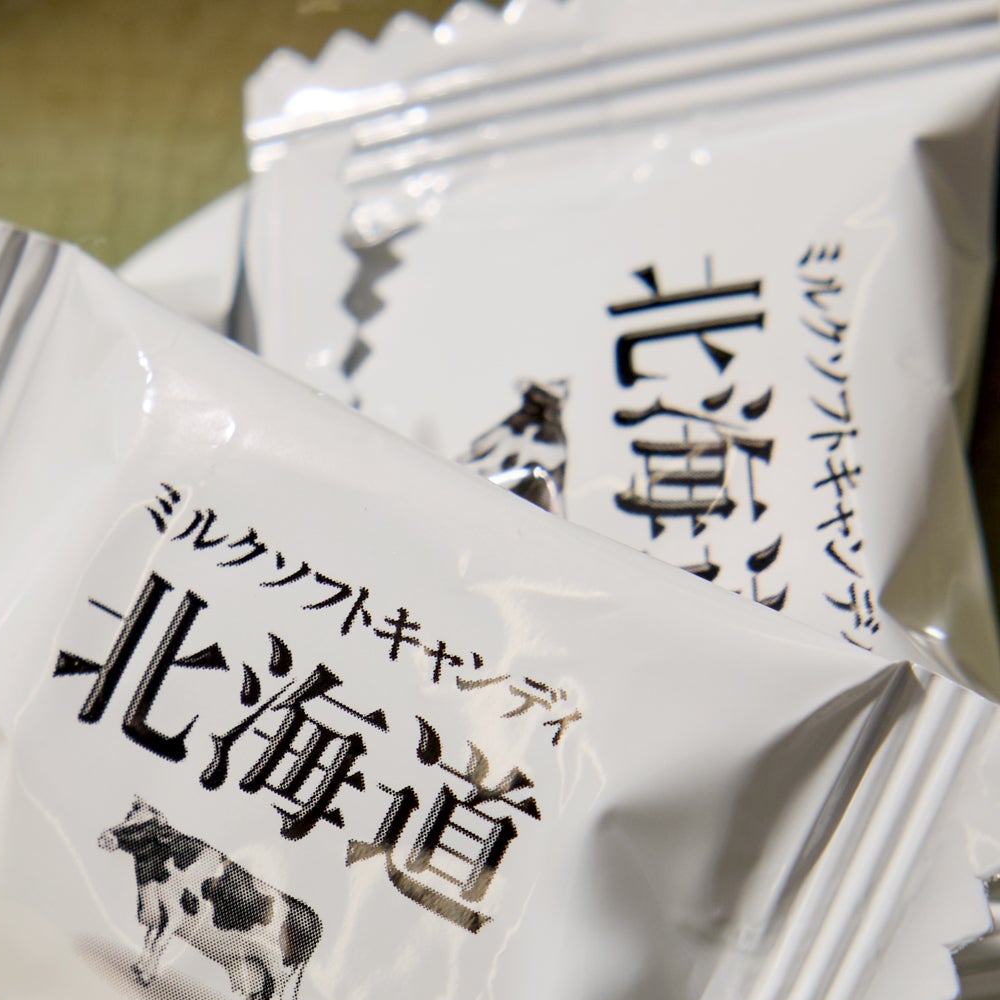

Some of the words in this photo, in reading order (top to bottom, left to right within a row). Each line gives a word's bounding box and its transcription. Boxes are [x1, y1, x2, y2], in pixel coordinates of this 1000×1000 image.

[52, 571, 542, 933] 北海道
[147, 482, 583, 746] ミルクソフトキャンディ
